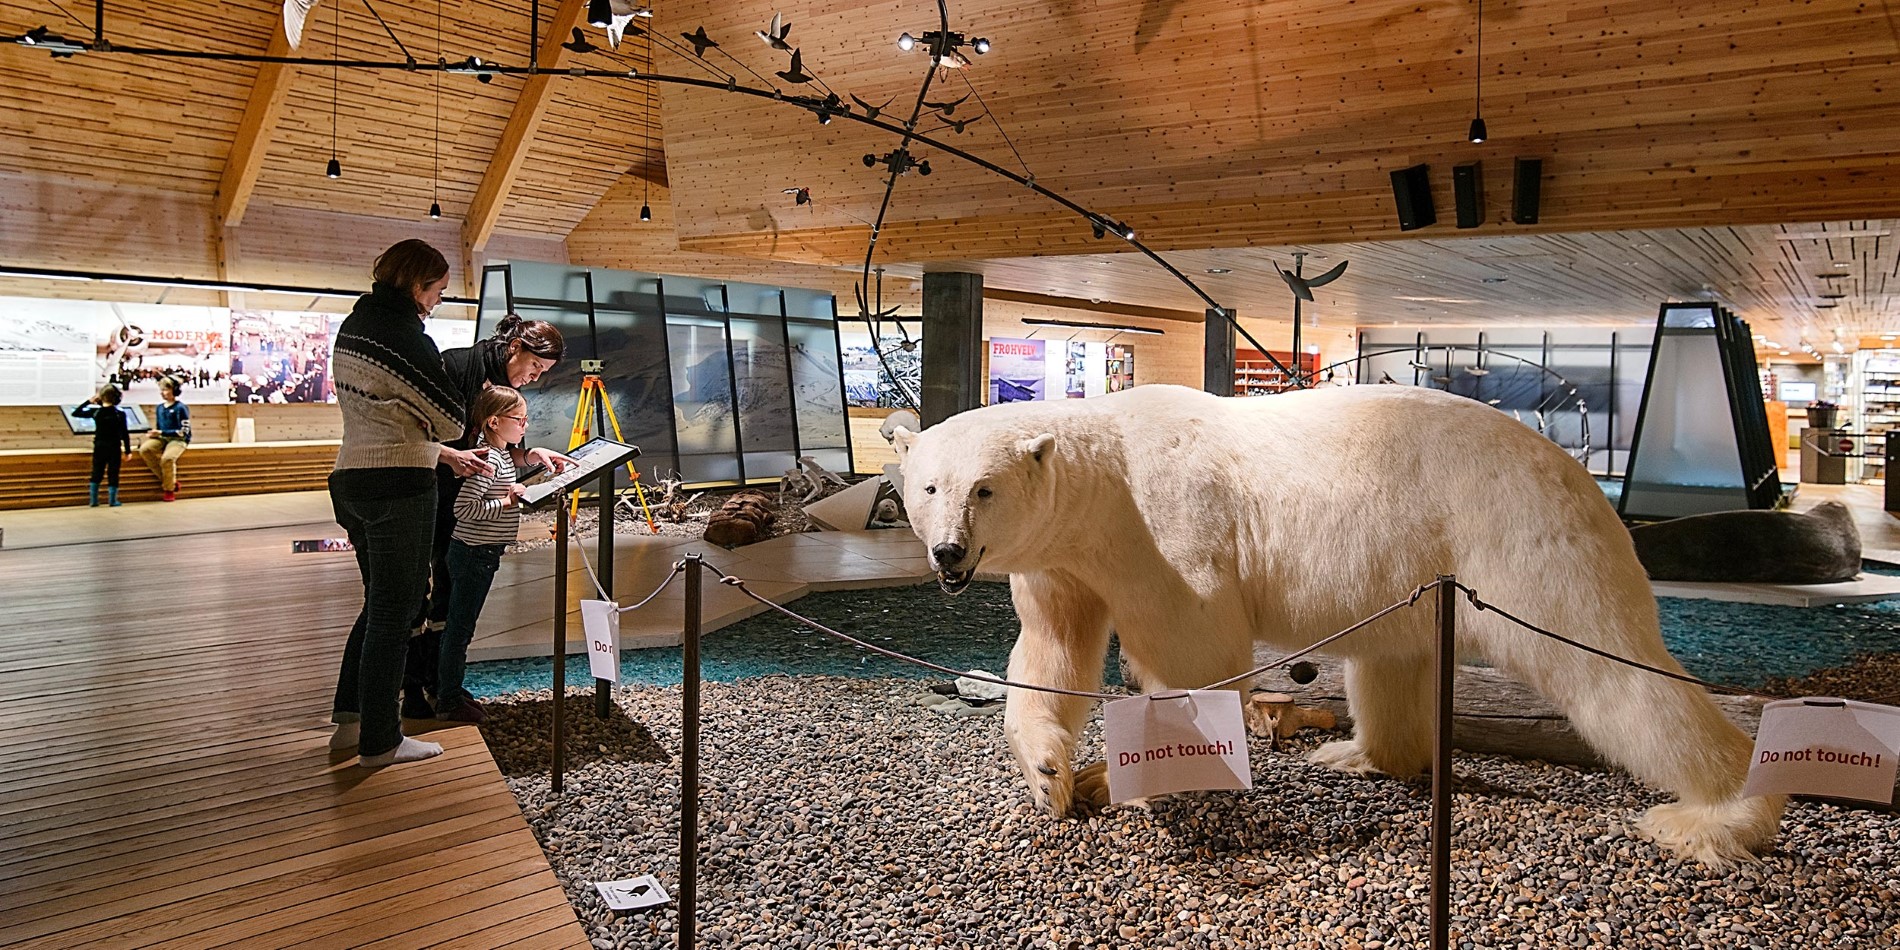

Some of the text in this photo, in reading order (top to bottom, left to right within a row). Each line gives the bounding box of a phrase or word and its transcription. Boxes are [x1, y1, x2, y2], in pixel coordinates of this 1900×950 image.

[595, 641, 607, 653] Do
[1119, 740, 1233, 766] Do not touch!
[1760, 749, 1881, 768] Do not touch!
